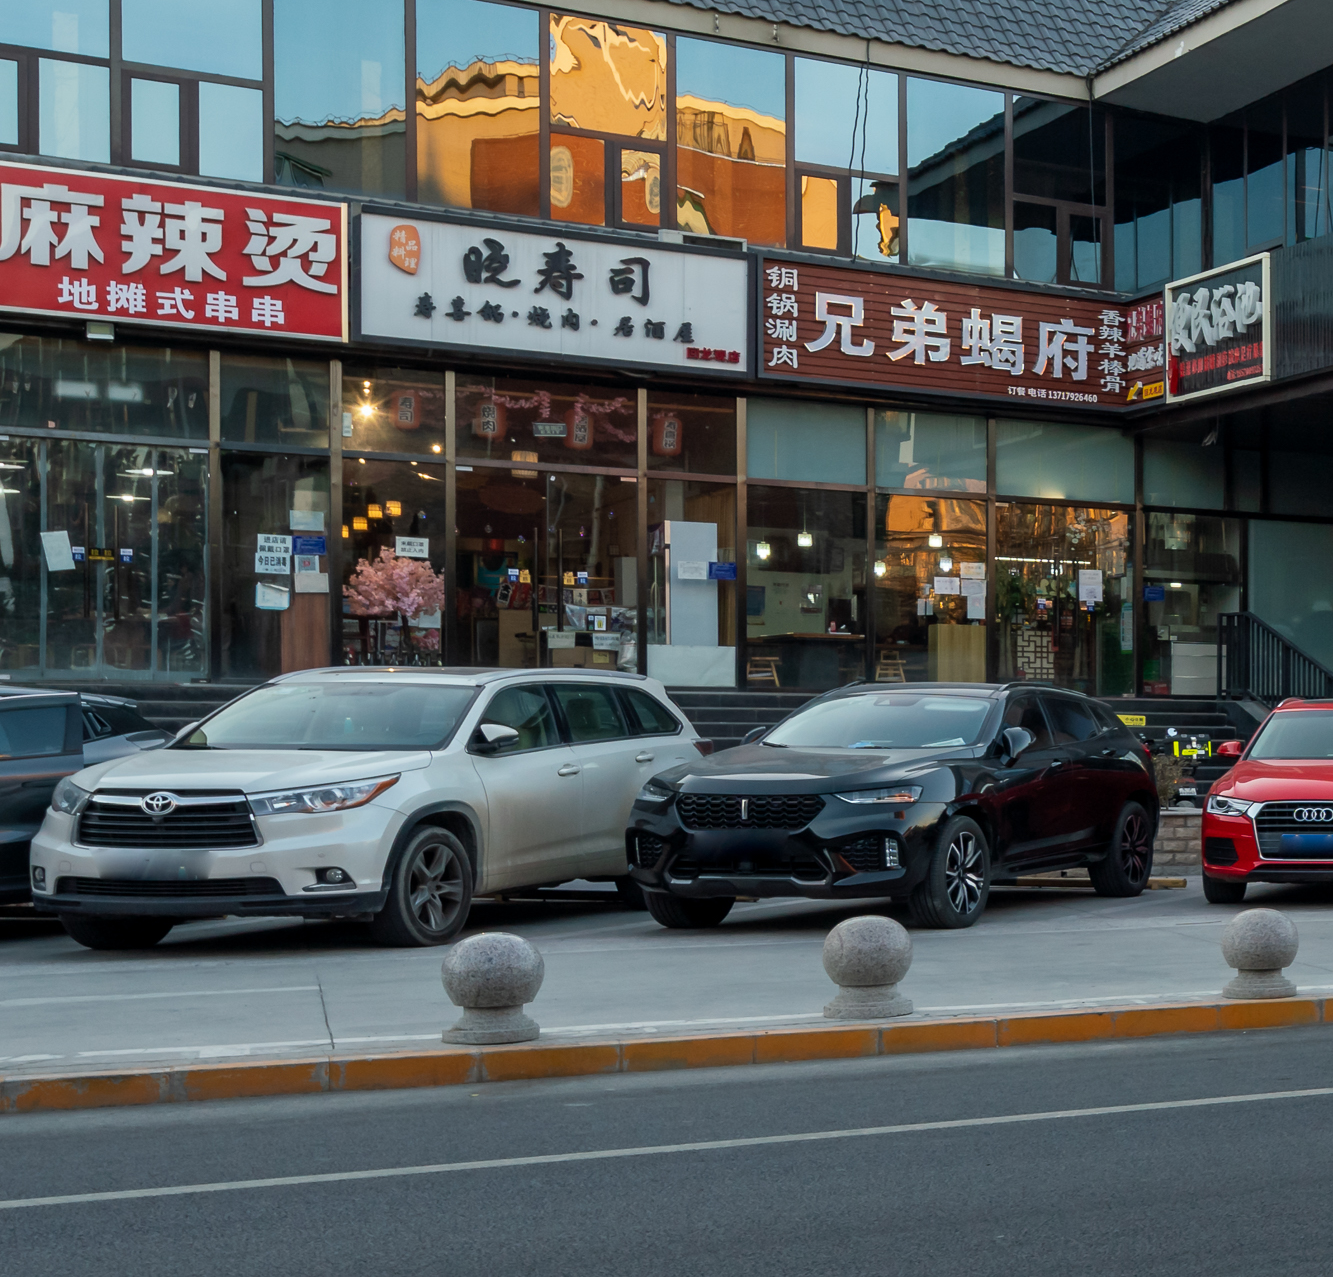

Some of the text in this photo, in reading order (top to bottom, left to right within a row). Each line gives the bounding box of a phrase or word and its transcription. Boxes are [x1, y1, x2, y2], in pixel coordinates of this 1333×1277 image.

[0, 183, 338, 294] 麻辣烫
[57, 276, 285, 327] 地摊式串串
[765, 265, 799, 369] 铜锅涮肉
[803, 291, 1096, 381] 兄弟蝎府
[1169, 281, 1263, 356] 便民浴池
[1028, 388, 1047, 398] 电话
[1098, 309, 1126, 393] 香辣羊棒骨
